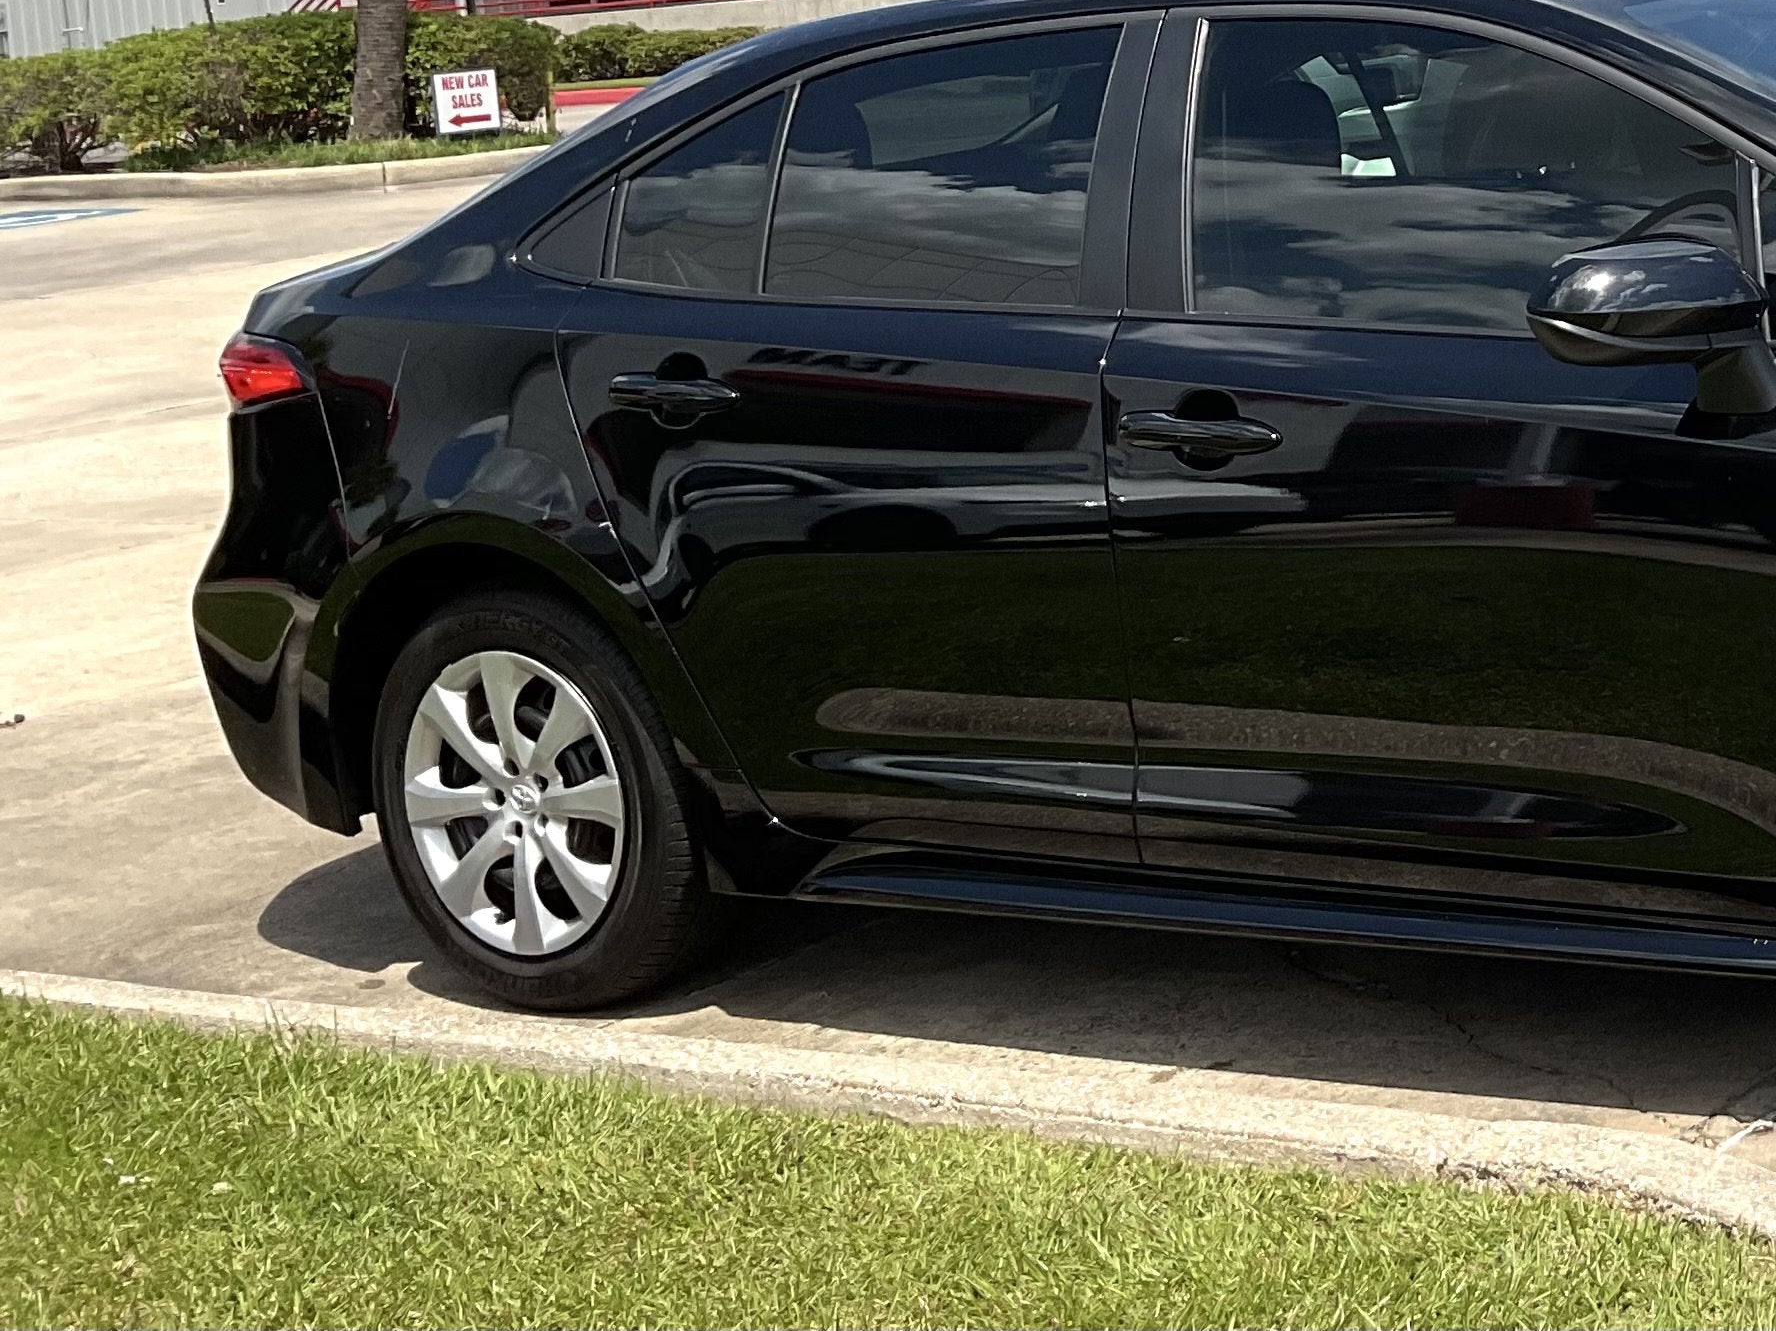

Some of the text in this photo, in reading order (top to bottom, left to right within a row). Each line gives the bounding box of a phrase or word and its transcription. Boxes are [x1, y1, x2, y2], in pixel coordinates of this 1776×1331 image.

[441, 73, 489, 91] NEW CAR
[452, 93, 483, 109] SALES
